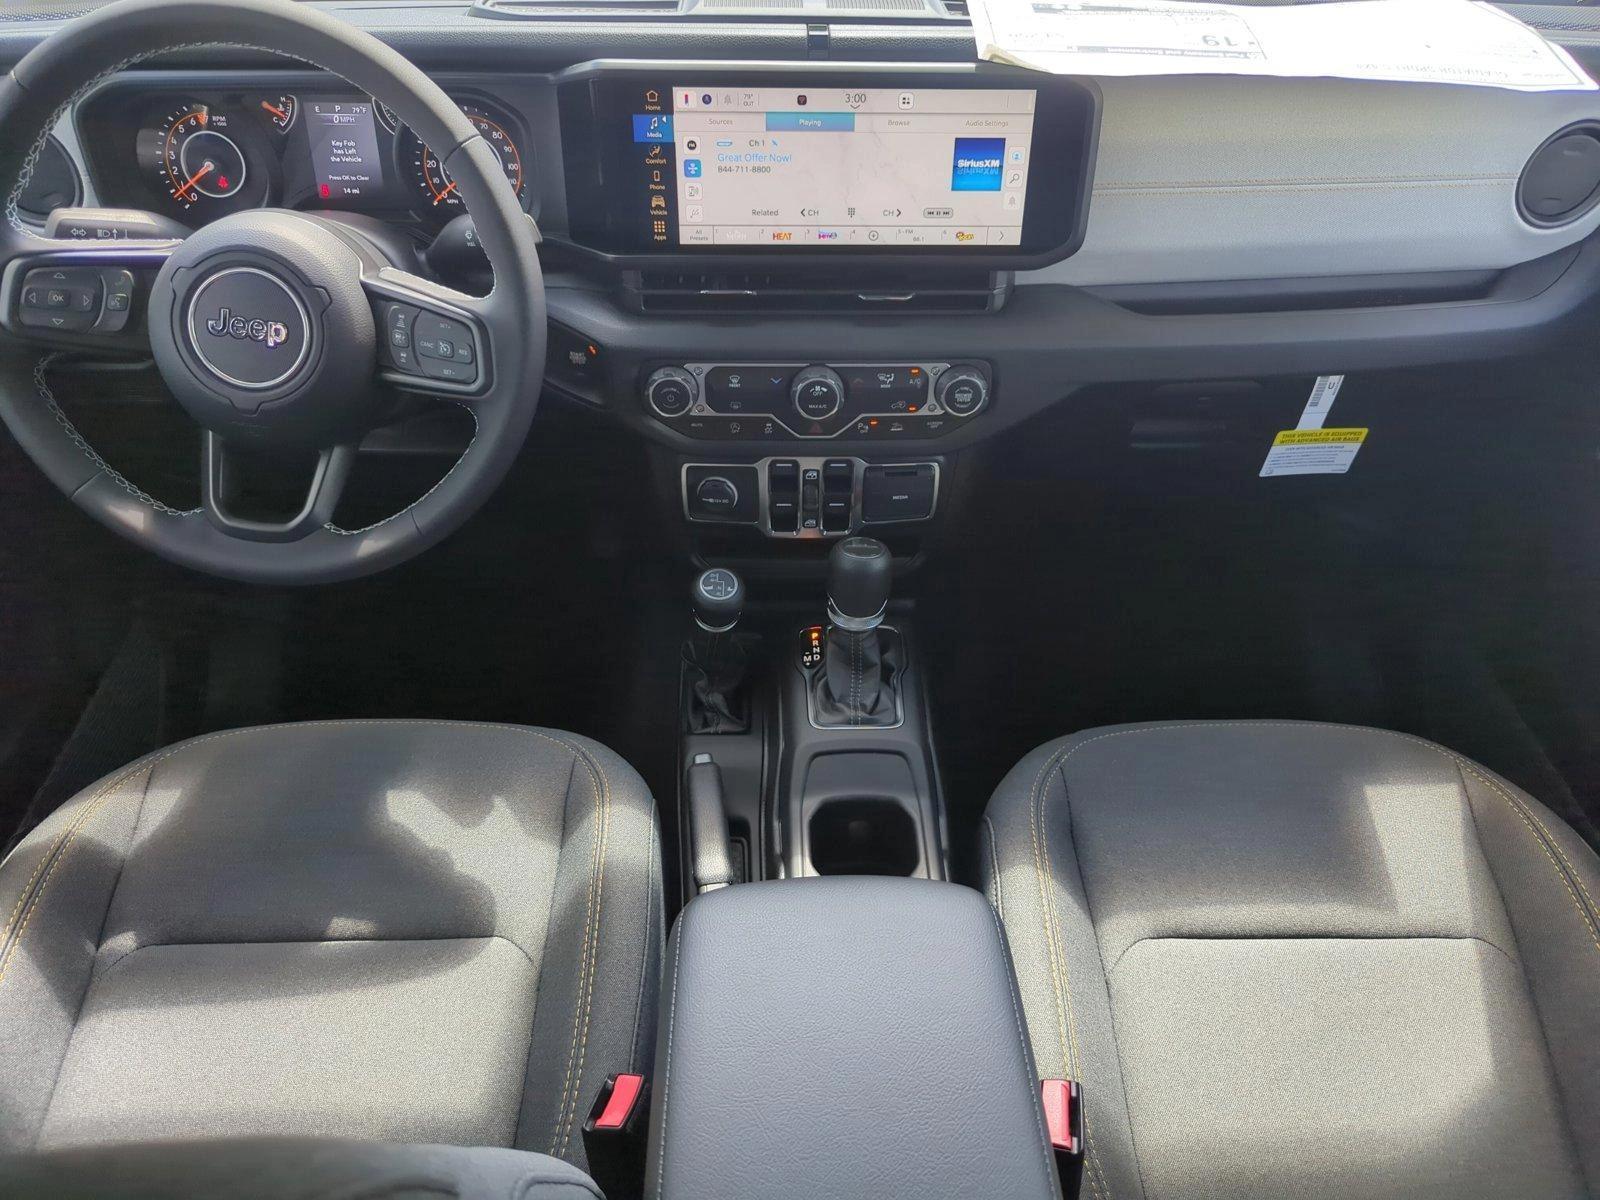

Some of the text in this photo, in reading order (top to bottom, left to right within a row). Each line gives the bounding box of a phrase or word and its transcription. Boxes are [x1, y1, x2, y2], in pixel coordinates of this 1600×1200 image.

[844, 93, 866, 104] 3:00
[190, 118, 196, 126] 6
[333, 115, 339, 123] 0
[799, 119, 822, 128] Playing
[985, 120, 1009, 128] Settings
[178, 125, 184, 133] 5
[171, 137, 177, 145] 4
[169, 151, 176, 160] 3
[717, 154, 742, 162] Great
[744, 153, 769, 162] Offer
[957, 159, 1000, 168] SiriusXM
[172, 167, 179, 175] 2
[717, 166, 772, 174] 844-711-8800
[191, 193, 198, 201] 0
[654, 234, 667, 242] Apps
[773, 232, 792, 240] HEAT
[208, 308, 288, 346] Jeep
